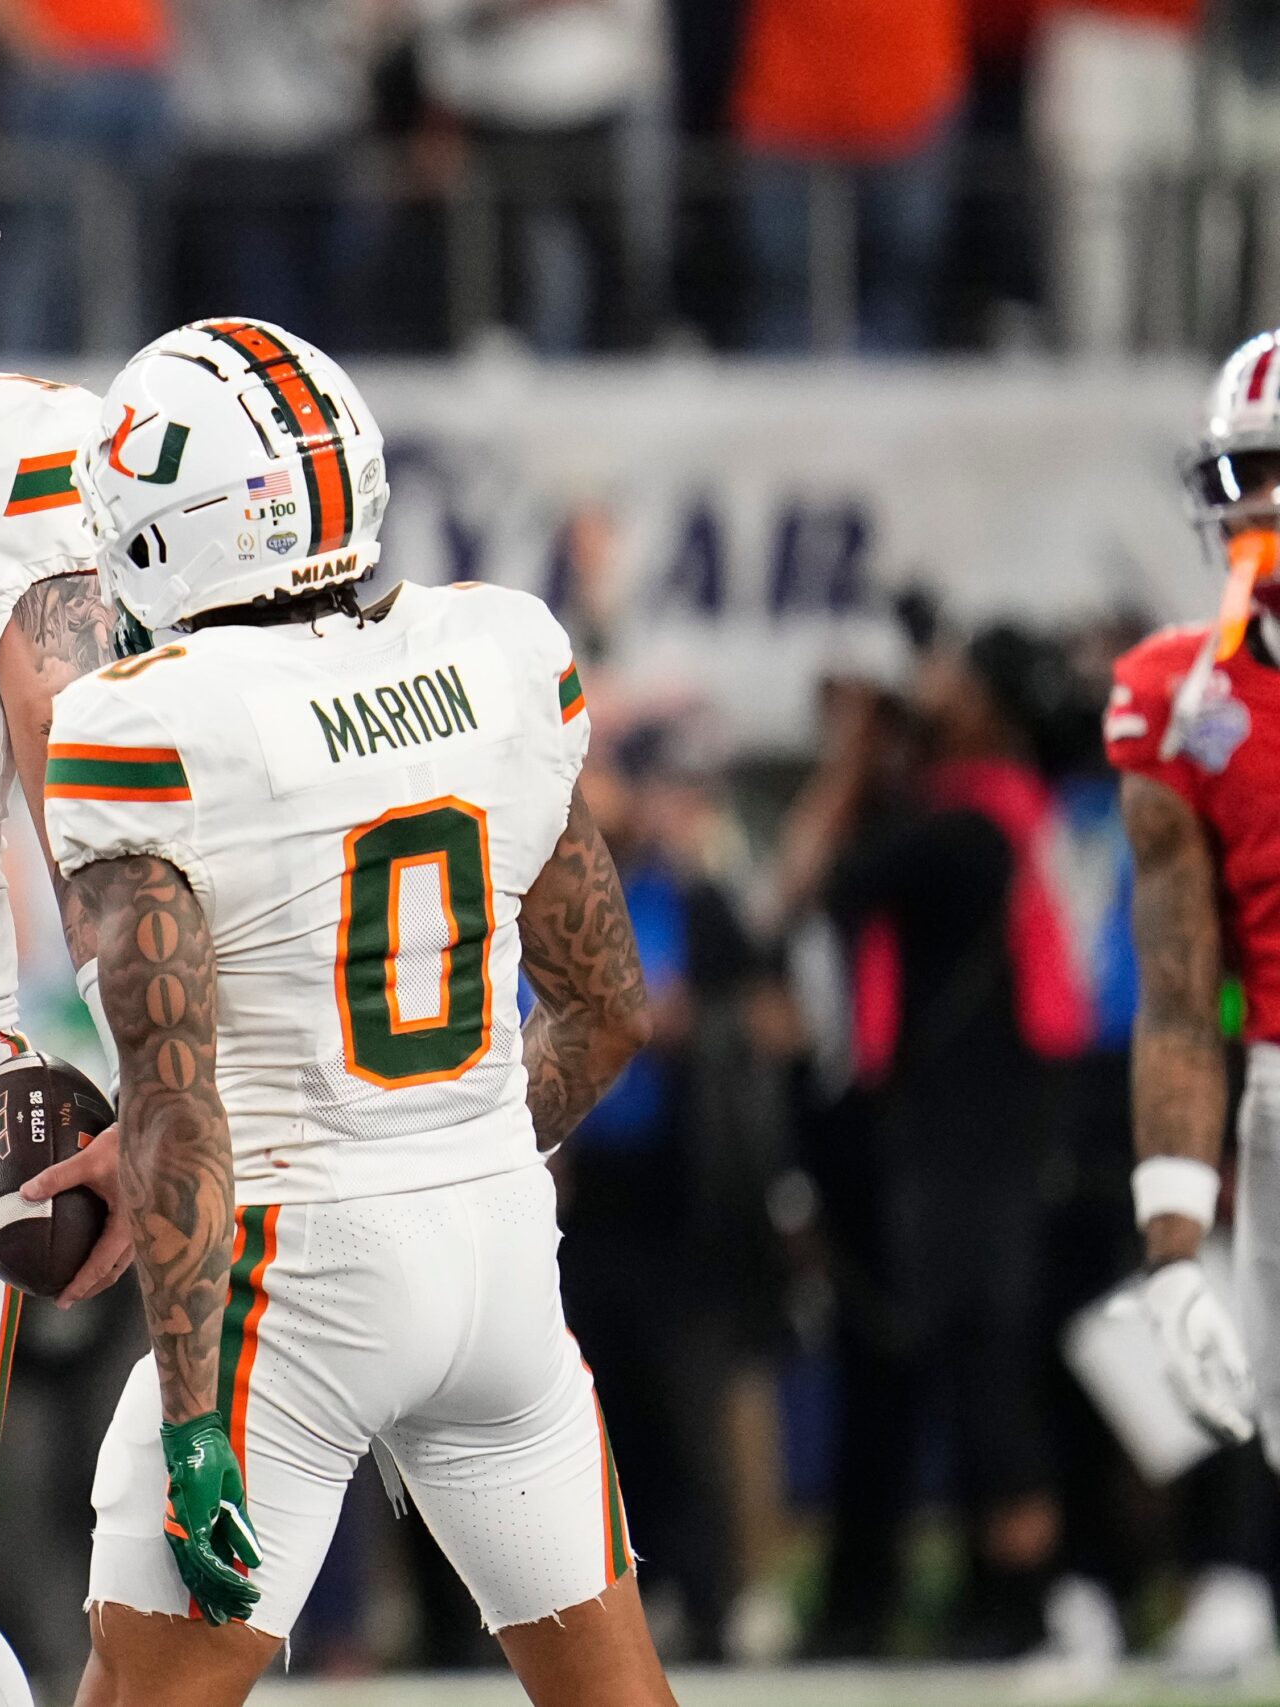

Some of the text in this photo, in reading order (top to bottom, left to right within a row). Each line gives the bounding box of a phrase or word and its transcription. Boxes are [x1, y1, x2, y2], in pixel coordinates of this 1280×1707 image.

[108, 404, 190, 484] U
[269, 502, 297, 518] 100
[291, 554, 357, 587] MIAMI
[310, 665, 478, 763] MARION
[334, 794, 495, 1090] 0
